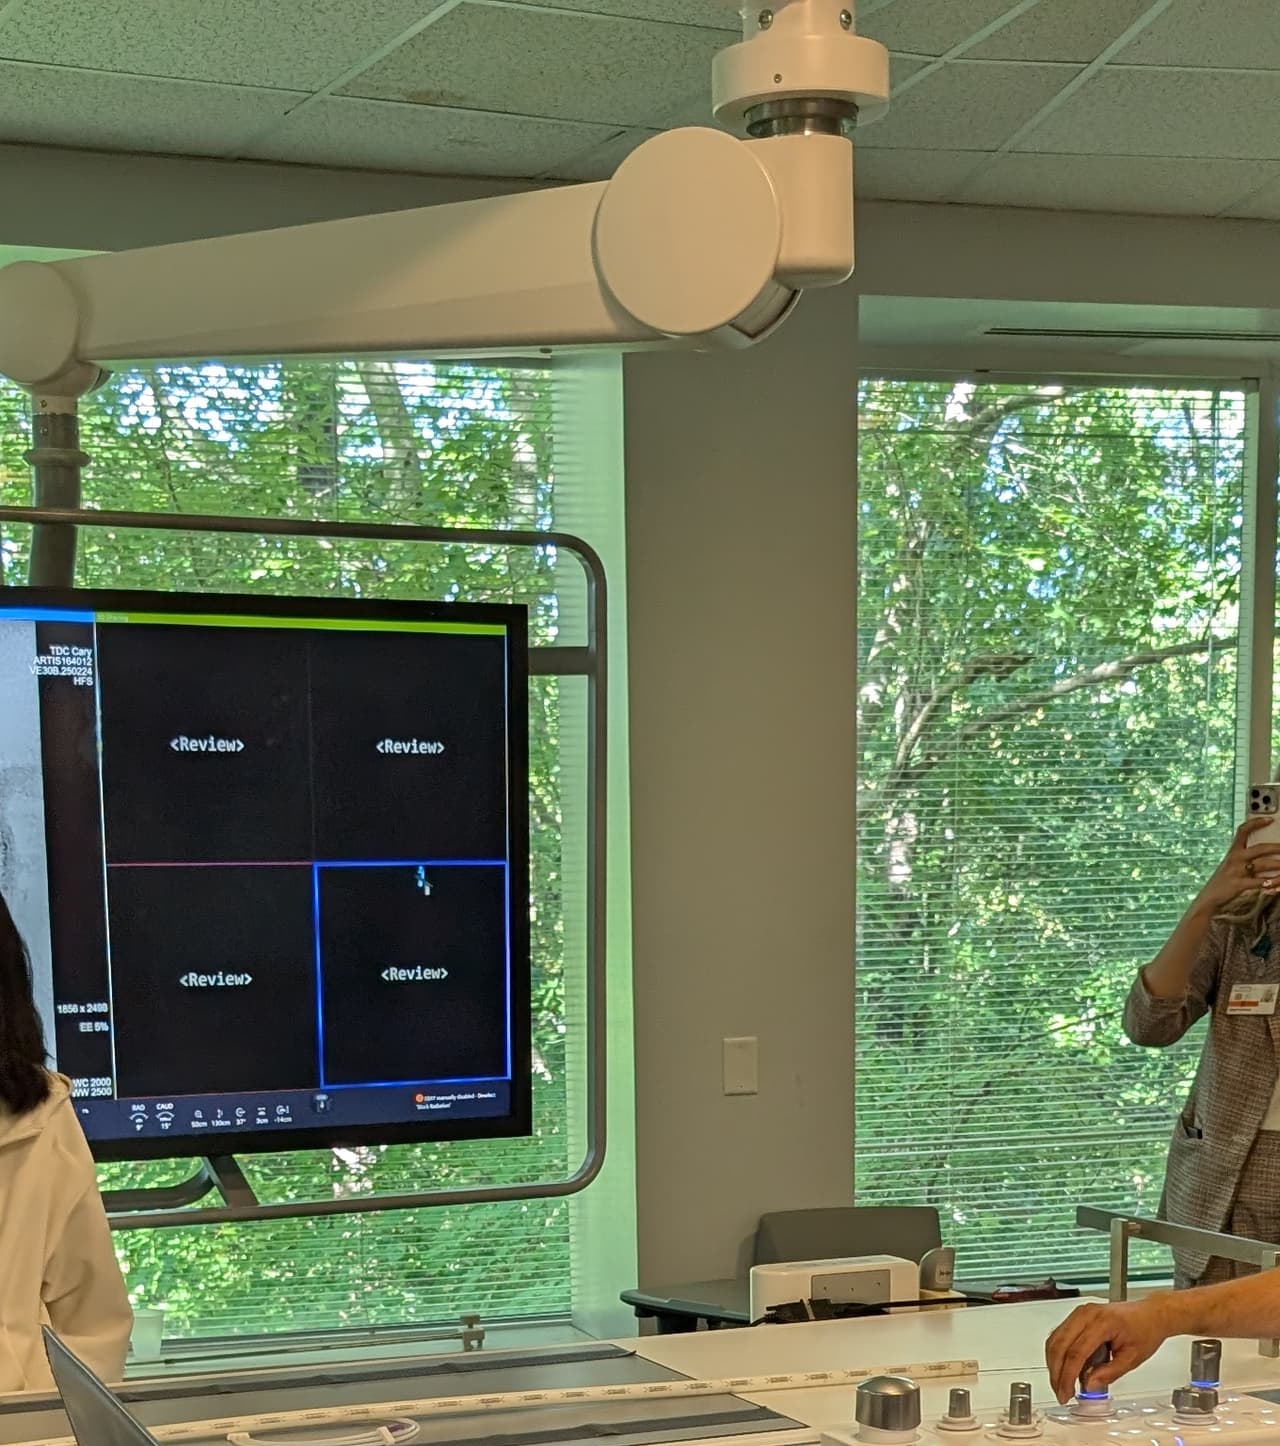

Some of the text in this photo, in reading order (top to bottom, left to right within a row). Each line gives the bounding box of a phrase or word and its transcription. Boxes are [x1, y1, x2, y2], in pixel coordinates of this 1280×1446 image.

[49, 645, 93, 658] TDC Cary
[33, 656, 93, 666] ARTIS164012
[73, 676, 94, 686] HFS
[170, 734, 245, 752] <Review>
[376, 738, 445, 754] <Review>
[179, 971, 253, 987] <Review>
[381, 965, 449, 981] <Review>
[91, 1078, 112, 1087] 2000
[91, 1087, 112, 1097] 2500
